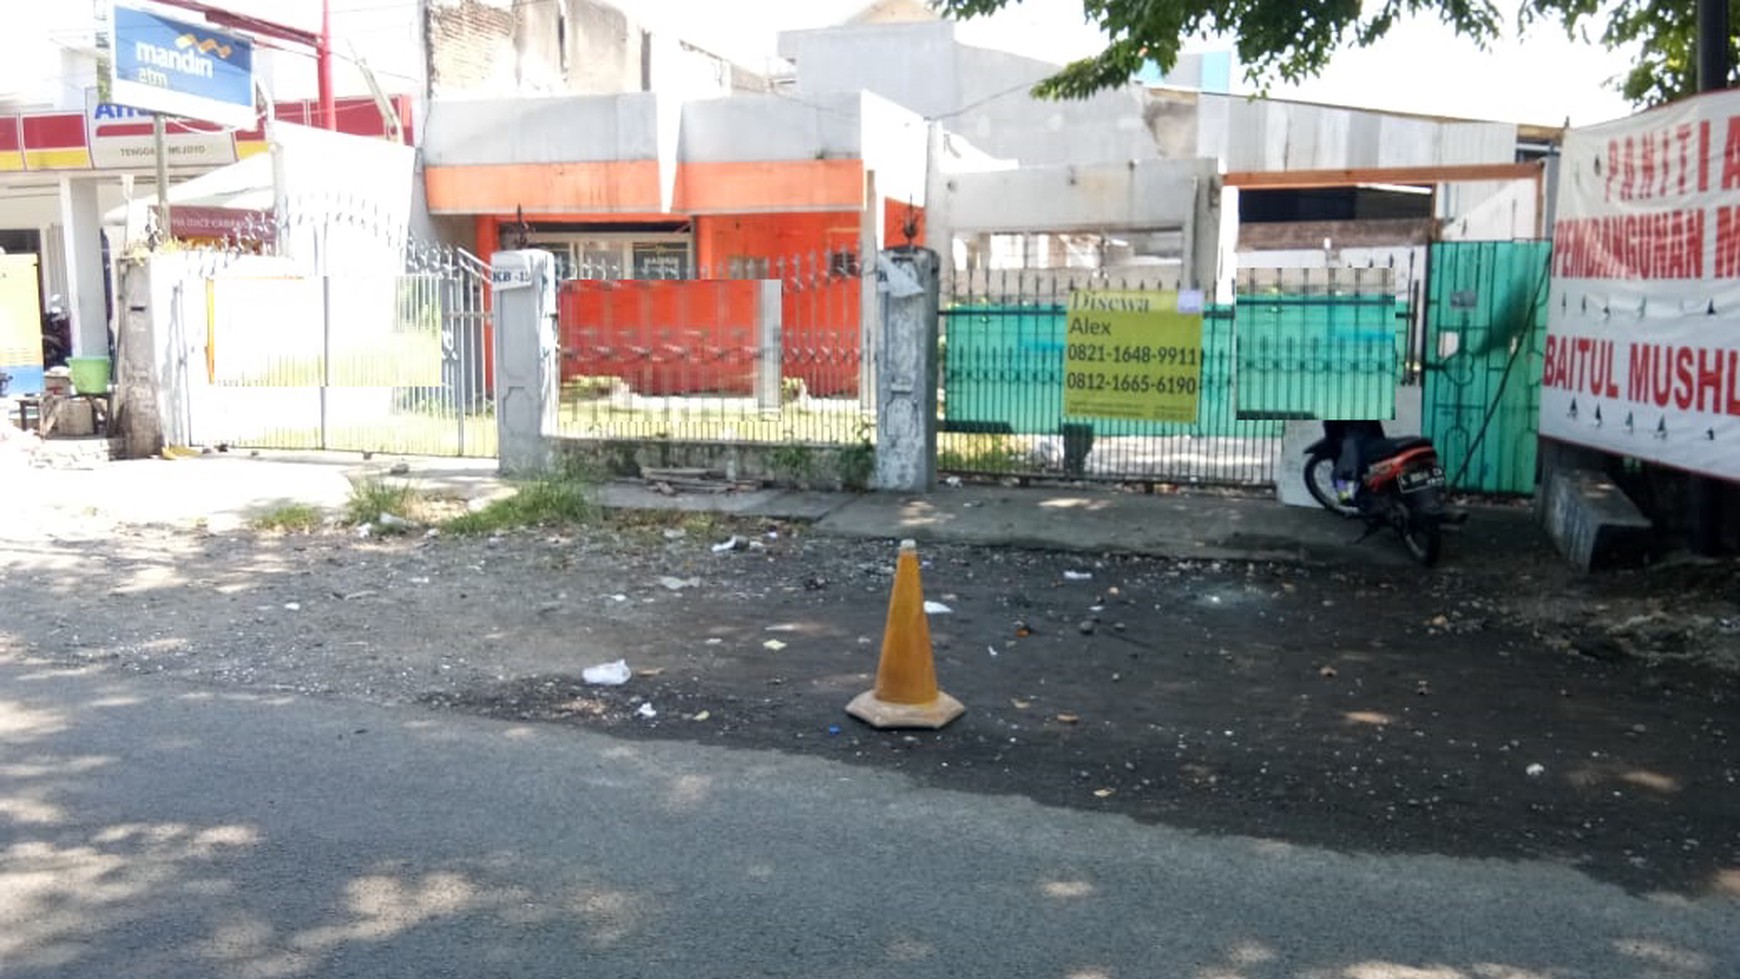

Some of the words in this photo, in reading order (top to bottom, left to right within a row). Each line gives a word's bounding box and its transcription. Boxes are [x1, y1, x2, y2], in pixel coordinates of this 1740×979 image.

[138, 66, 168, 89] atm
[1551, 207, 1705, 280] PEMBANGUNAN
[1069, 316, 1112, 336] Alex
[1068, 343, 1197, 366] 0821-1648-9911
[1542, 334, 1619, 399] BAITUL
[1066, 372, 1197, 395] 0812-1665-6190
